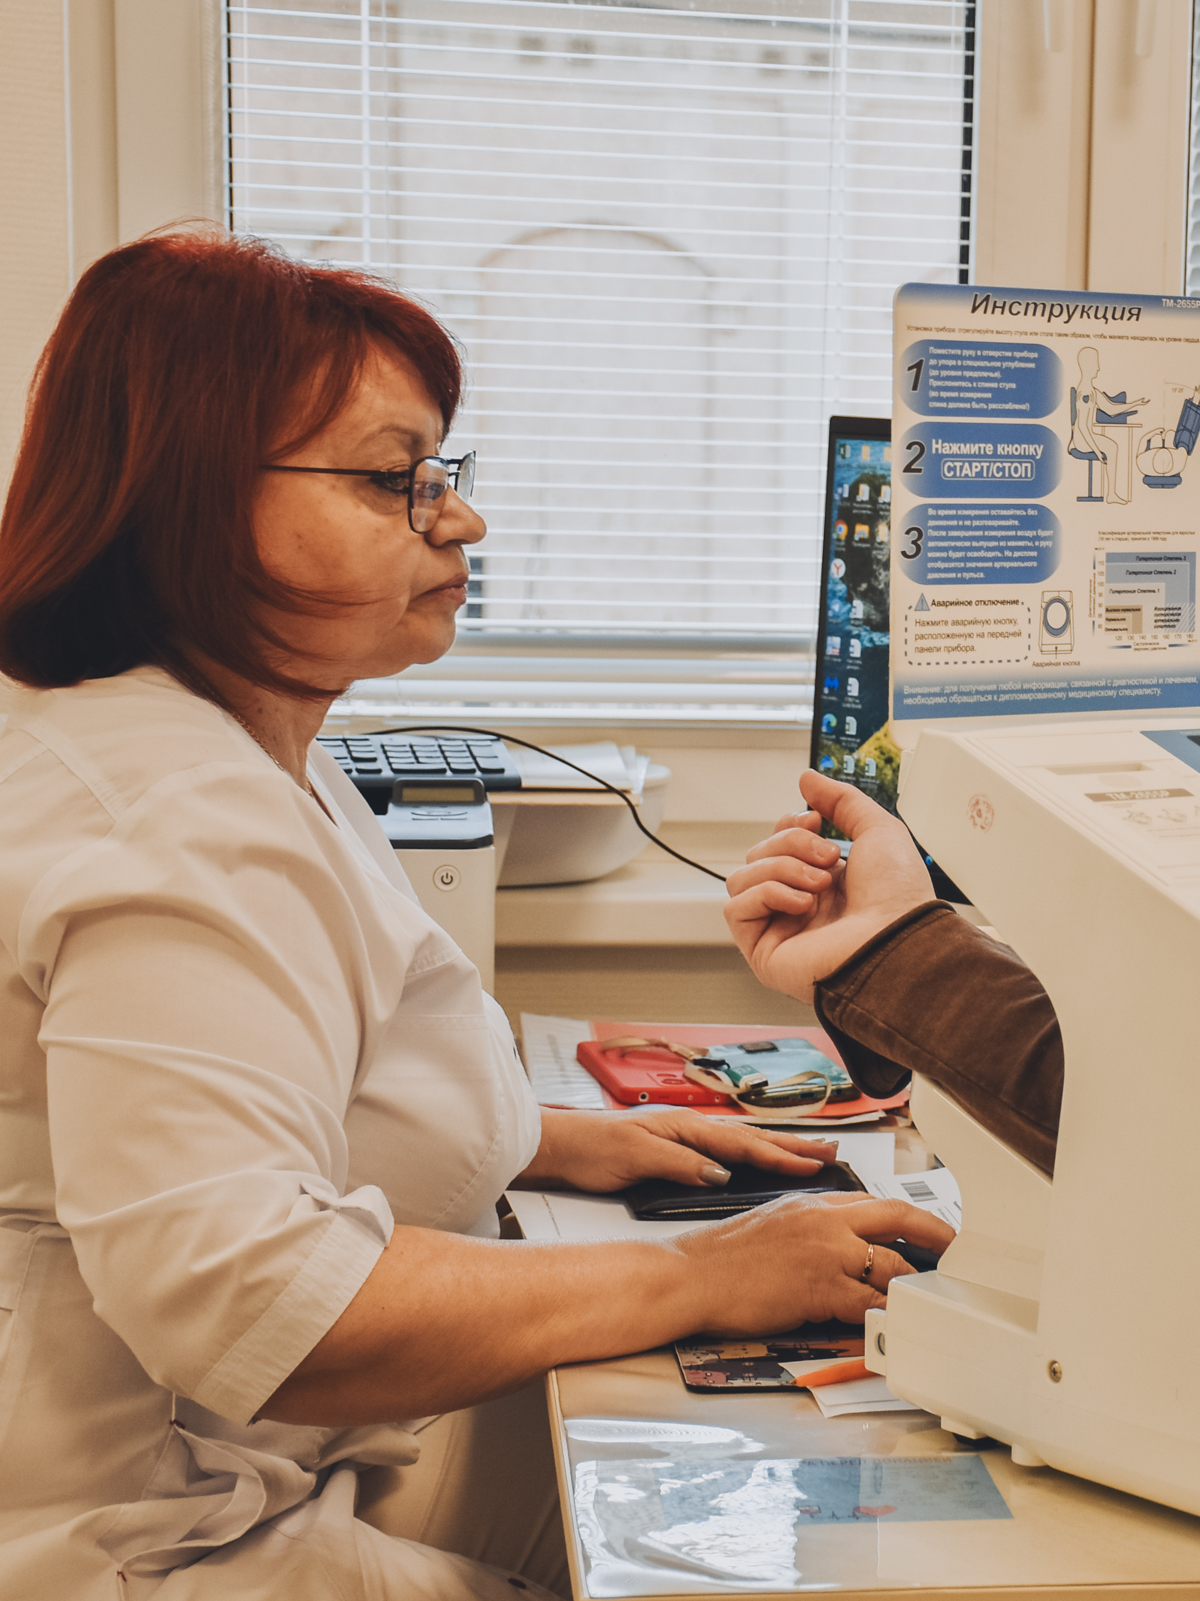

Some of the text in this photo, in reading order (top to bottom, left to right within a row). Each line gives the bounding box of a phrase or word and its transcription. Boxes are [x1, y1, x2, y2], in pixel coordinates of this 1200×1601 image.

[970, 293, 1142, 325] Инструкция
[934, 326, 956, 334] прибора:
[929, 347, 961, 355] Поместите
[982, 350, 1012, 358] отверстие
[1013, 351, 1038, 359] прибора
[963, 360, 1001, 368] специальное
[1002, 361, 1036, 369] углубление
[906, 358, 925, 392] 1
[940, 370, 962, 378] уровня
[963, 370, 1002, 379] предплечья).
[929, 379, 972, 388] Прислонитесь
[999, 382, 1017, 390] стула
[929, 390, 939, 398] (во
[948, 402, 971, 410] должна
[971, 401, 987, 409] быть
[932, 439, 1044, 459] Нажмите кнопку
[902, 440, 926, 474] 2
[943, 461, 1032, 478] СТАРТ/СТОП
[927, 508, 937, 516] Во
[990, 508, 1026, 516] оставайтесь
[1027, 508, 1038, 516] без
[972, 519, 1020, 527] разговаривайте.
[1037, 529, 1054, 537] будет
[900, 526, 924, 559] 3
[948, 550, 966, 558] будет
[966, 550, 1003, 558] освободить.
[927, 561, 965, 569] отобразятся
[962, 572, 985, 580] пульса.
[931, 598, 973, 608] Аварийное
[915, 618, 1019, 627] Нажмите аварийную кнопку,
[914, 632, 974, 641] расположенную
[987, 630, 1022, 640] передней
[943, 644, 977, 653] прибора.
[904, 685, 942, 694] Внимание:
[944, 684, 957, 693] для
[959, 684, 997, 694] получения
[999, 682, 1021, 690] любой
[1023, 682, 1069, 691] информации,
[1070, 678, 1106, 688] связанной
[1112, 677, 1157, 687] диагностикой
[1164, 676, 1199, 685] лечением,
[903, 696, 948, 705] необходимо
[950, 694, 992, 703] обращаться
[998, 691, 1067, 700] дипломированному
[1068, 689, 1117, 698] медицинскому
[1119, 688, 1162, 696] специалисту.
